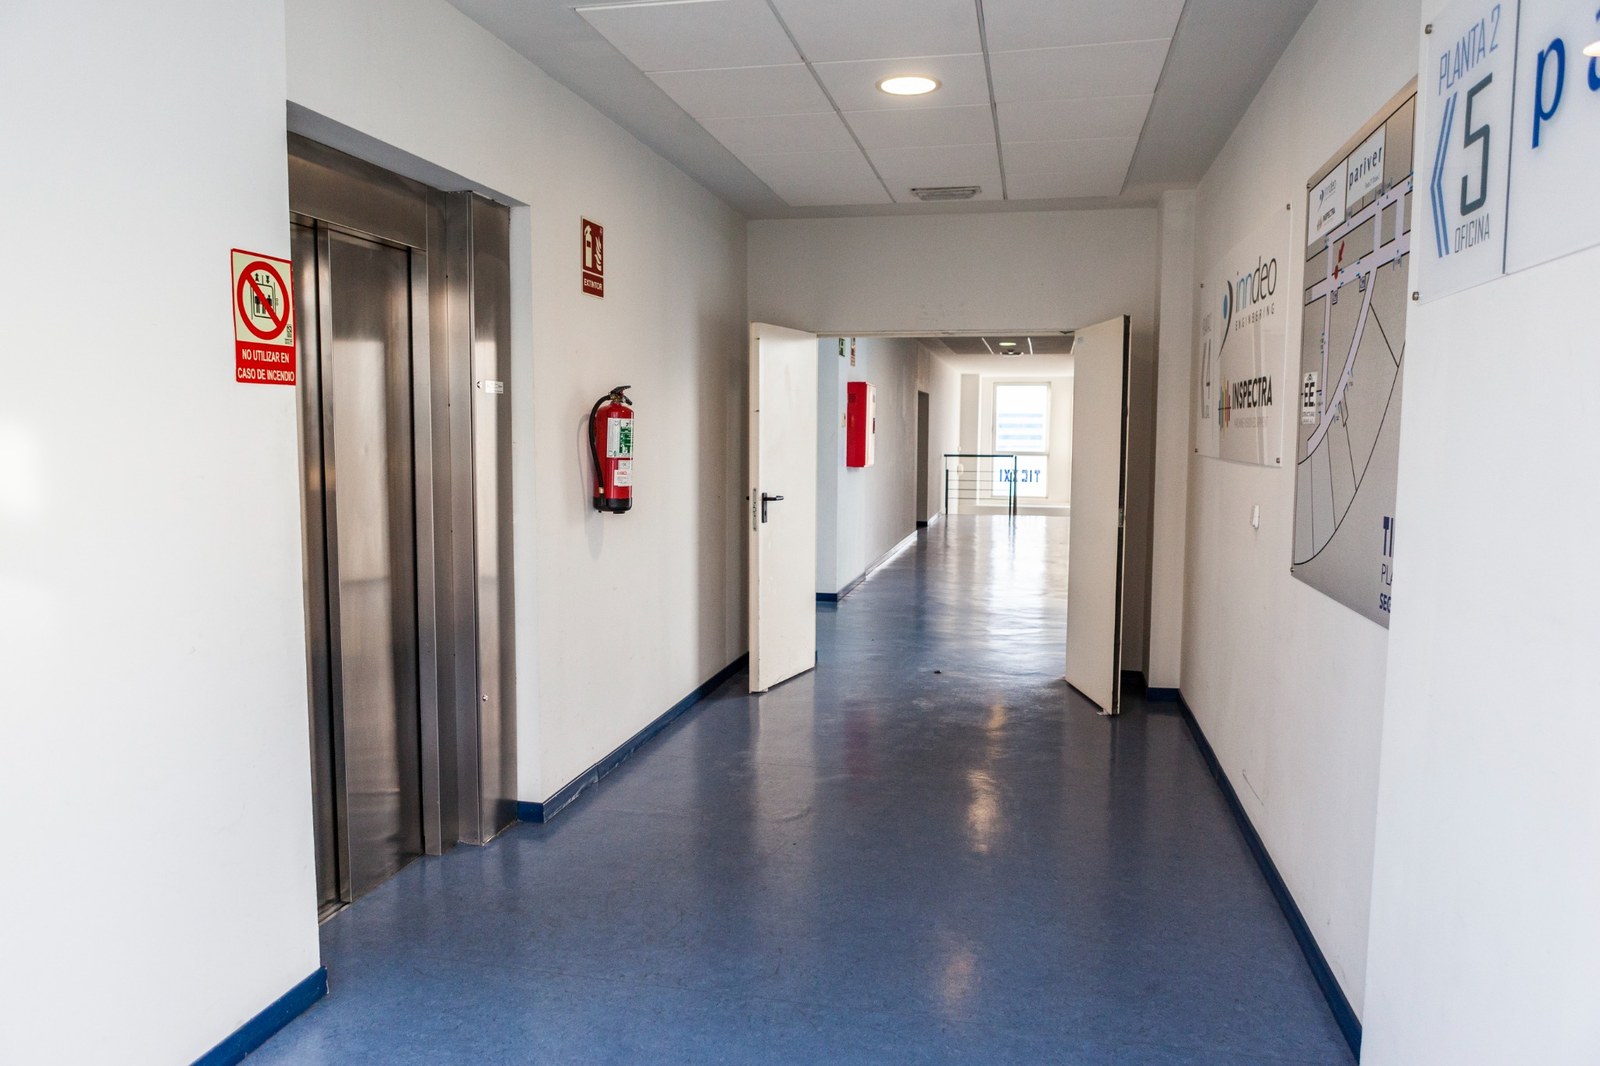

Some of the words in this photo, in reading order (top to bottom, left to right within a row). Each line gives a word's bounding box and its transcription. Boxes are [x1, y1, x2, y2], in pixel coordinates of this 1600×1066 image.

[1438, 18, 1486, 96] PLANTA
[1489, 3, 1502, 53] 2
[1460, 71, 1493, 217] 5
[1348, 146, 1383, 191] pariver
[1454, 213, 1491, 254] OFICINA
[583, 278, 603, 291] EXTINTOR
[1234, 255, 1278, 314] inndeo
[1235, 302, 1275, 332] ENGINEERING
[238, 368, 256, 379] CASO
[257, 369, 266, 380] DE
[267, 370, 295, 381] INCENDIO
[242, 349, 252, 360] NO
[253, 350, 280, 362] UTILIZAR
[281, 353, 289, 363] EN
[1231, 373, 1273, 410] INSPECTRA
